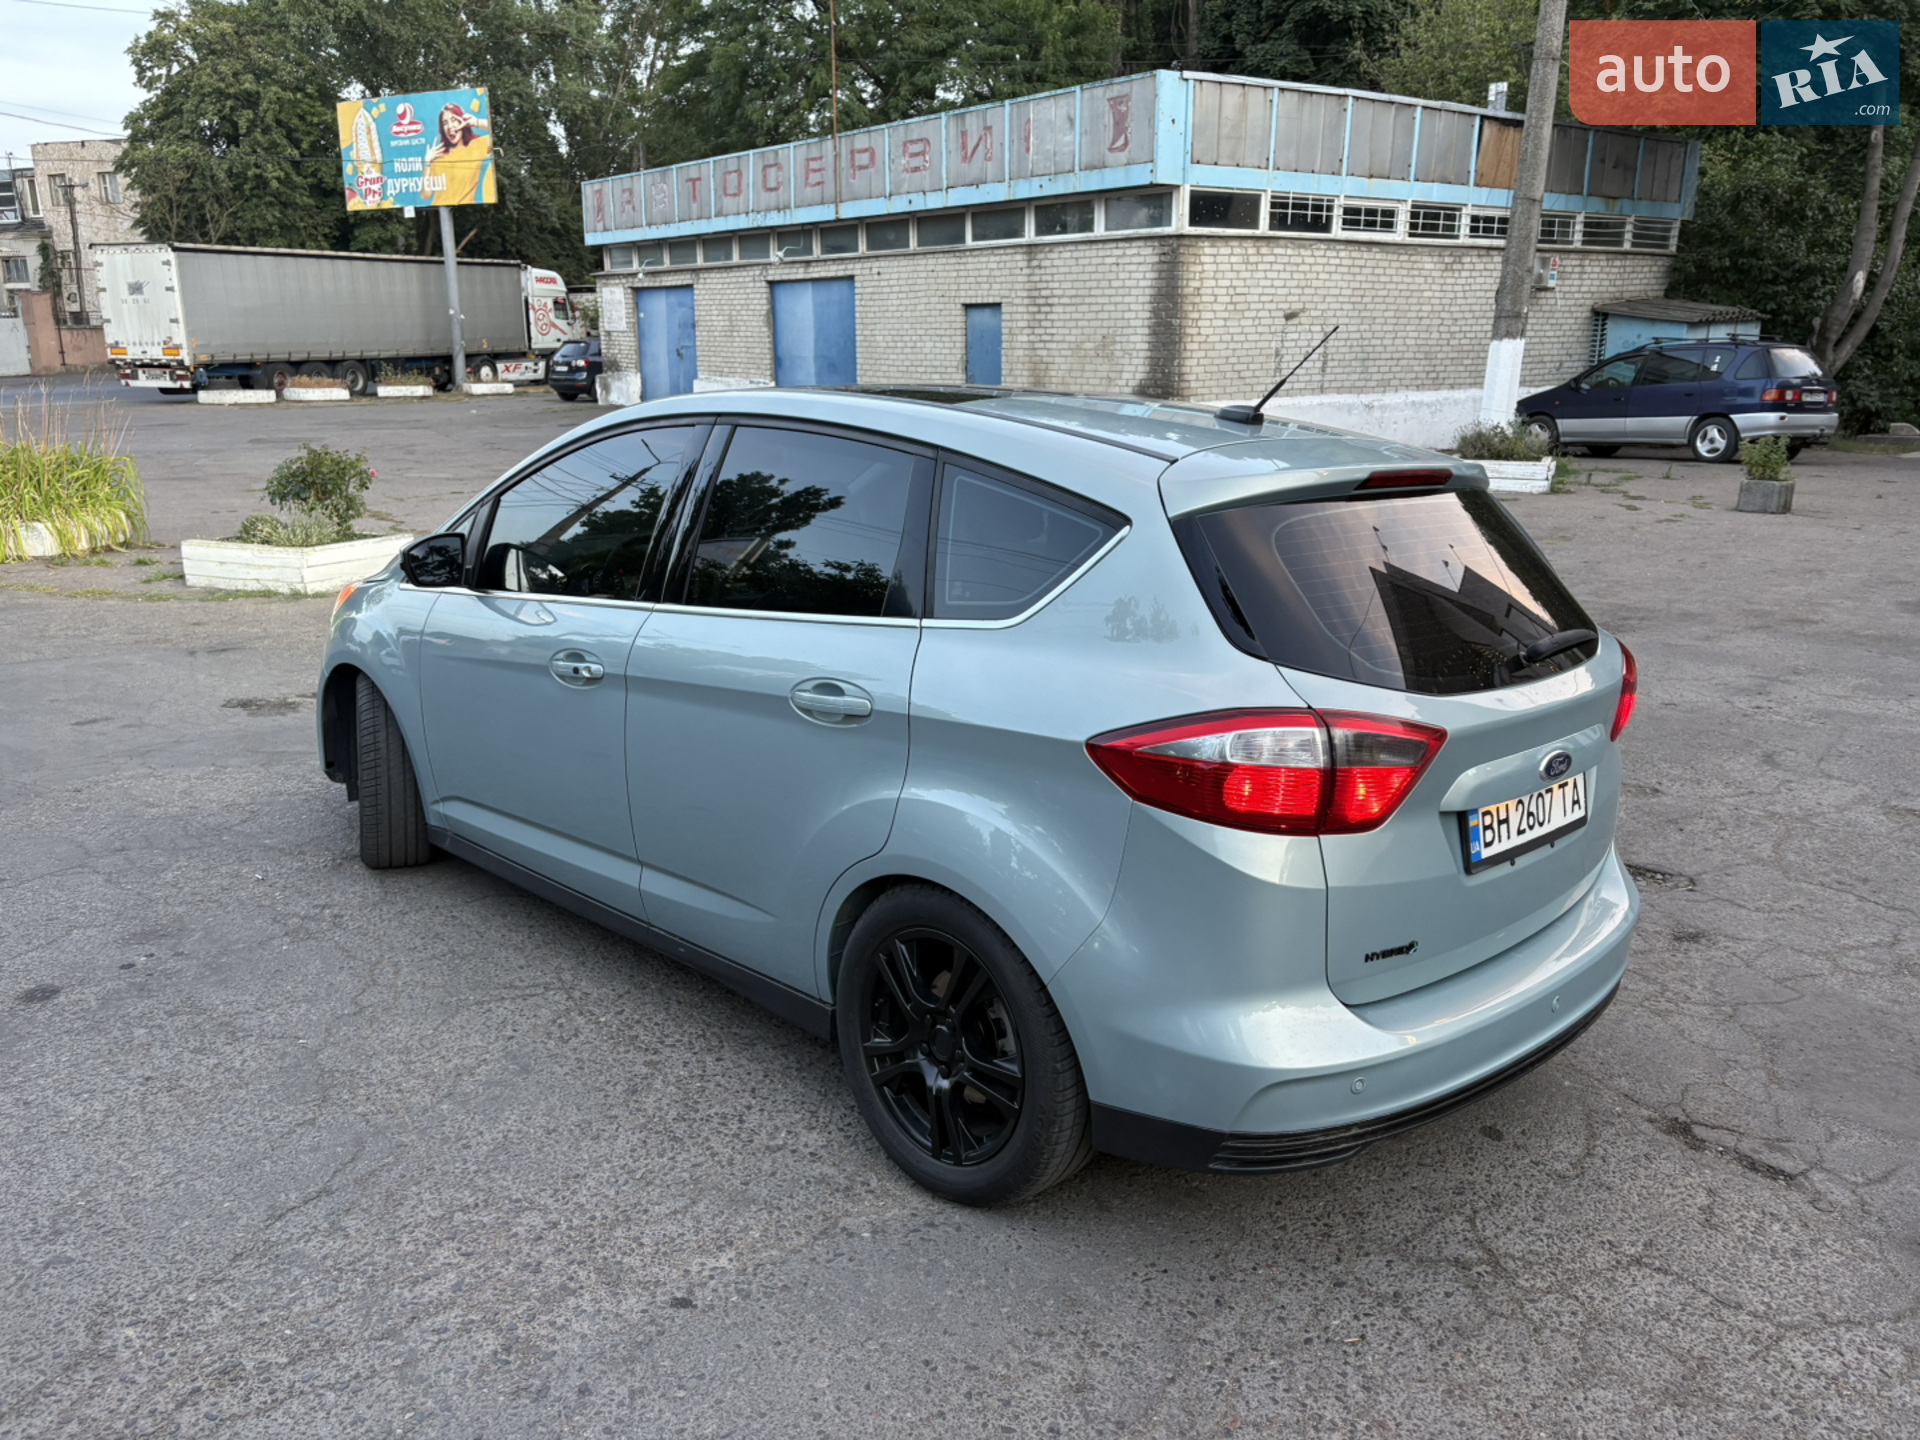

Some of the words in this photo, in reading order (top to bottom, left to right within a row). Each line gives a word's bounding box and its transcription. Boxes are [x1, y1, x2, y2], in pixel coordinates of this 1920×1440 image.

[393, 157, 423, 173] КОЛИ
[621, 119, 1030, 214] АВТОСЕРВИ
[501, 363, 523, 374] XF
[1550, 756, 1569, 776] Ford
[1481, 803, 1511, 849] BH
[1515, 787, 1554, 837] 2607
[1558, 777, 1582, 818] TA
[1470, 840, 1480, 854] UA
